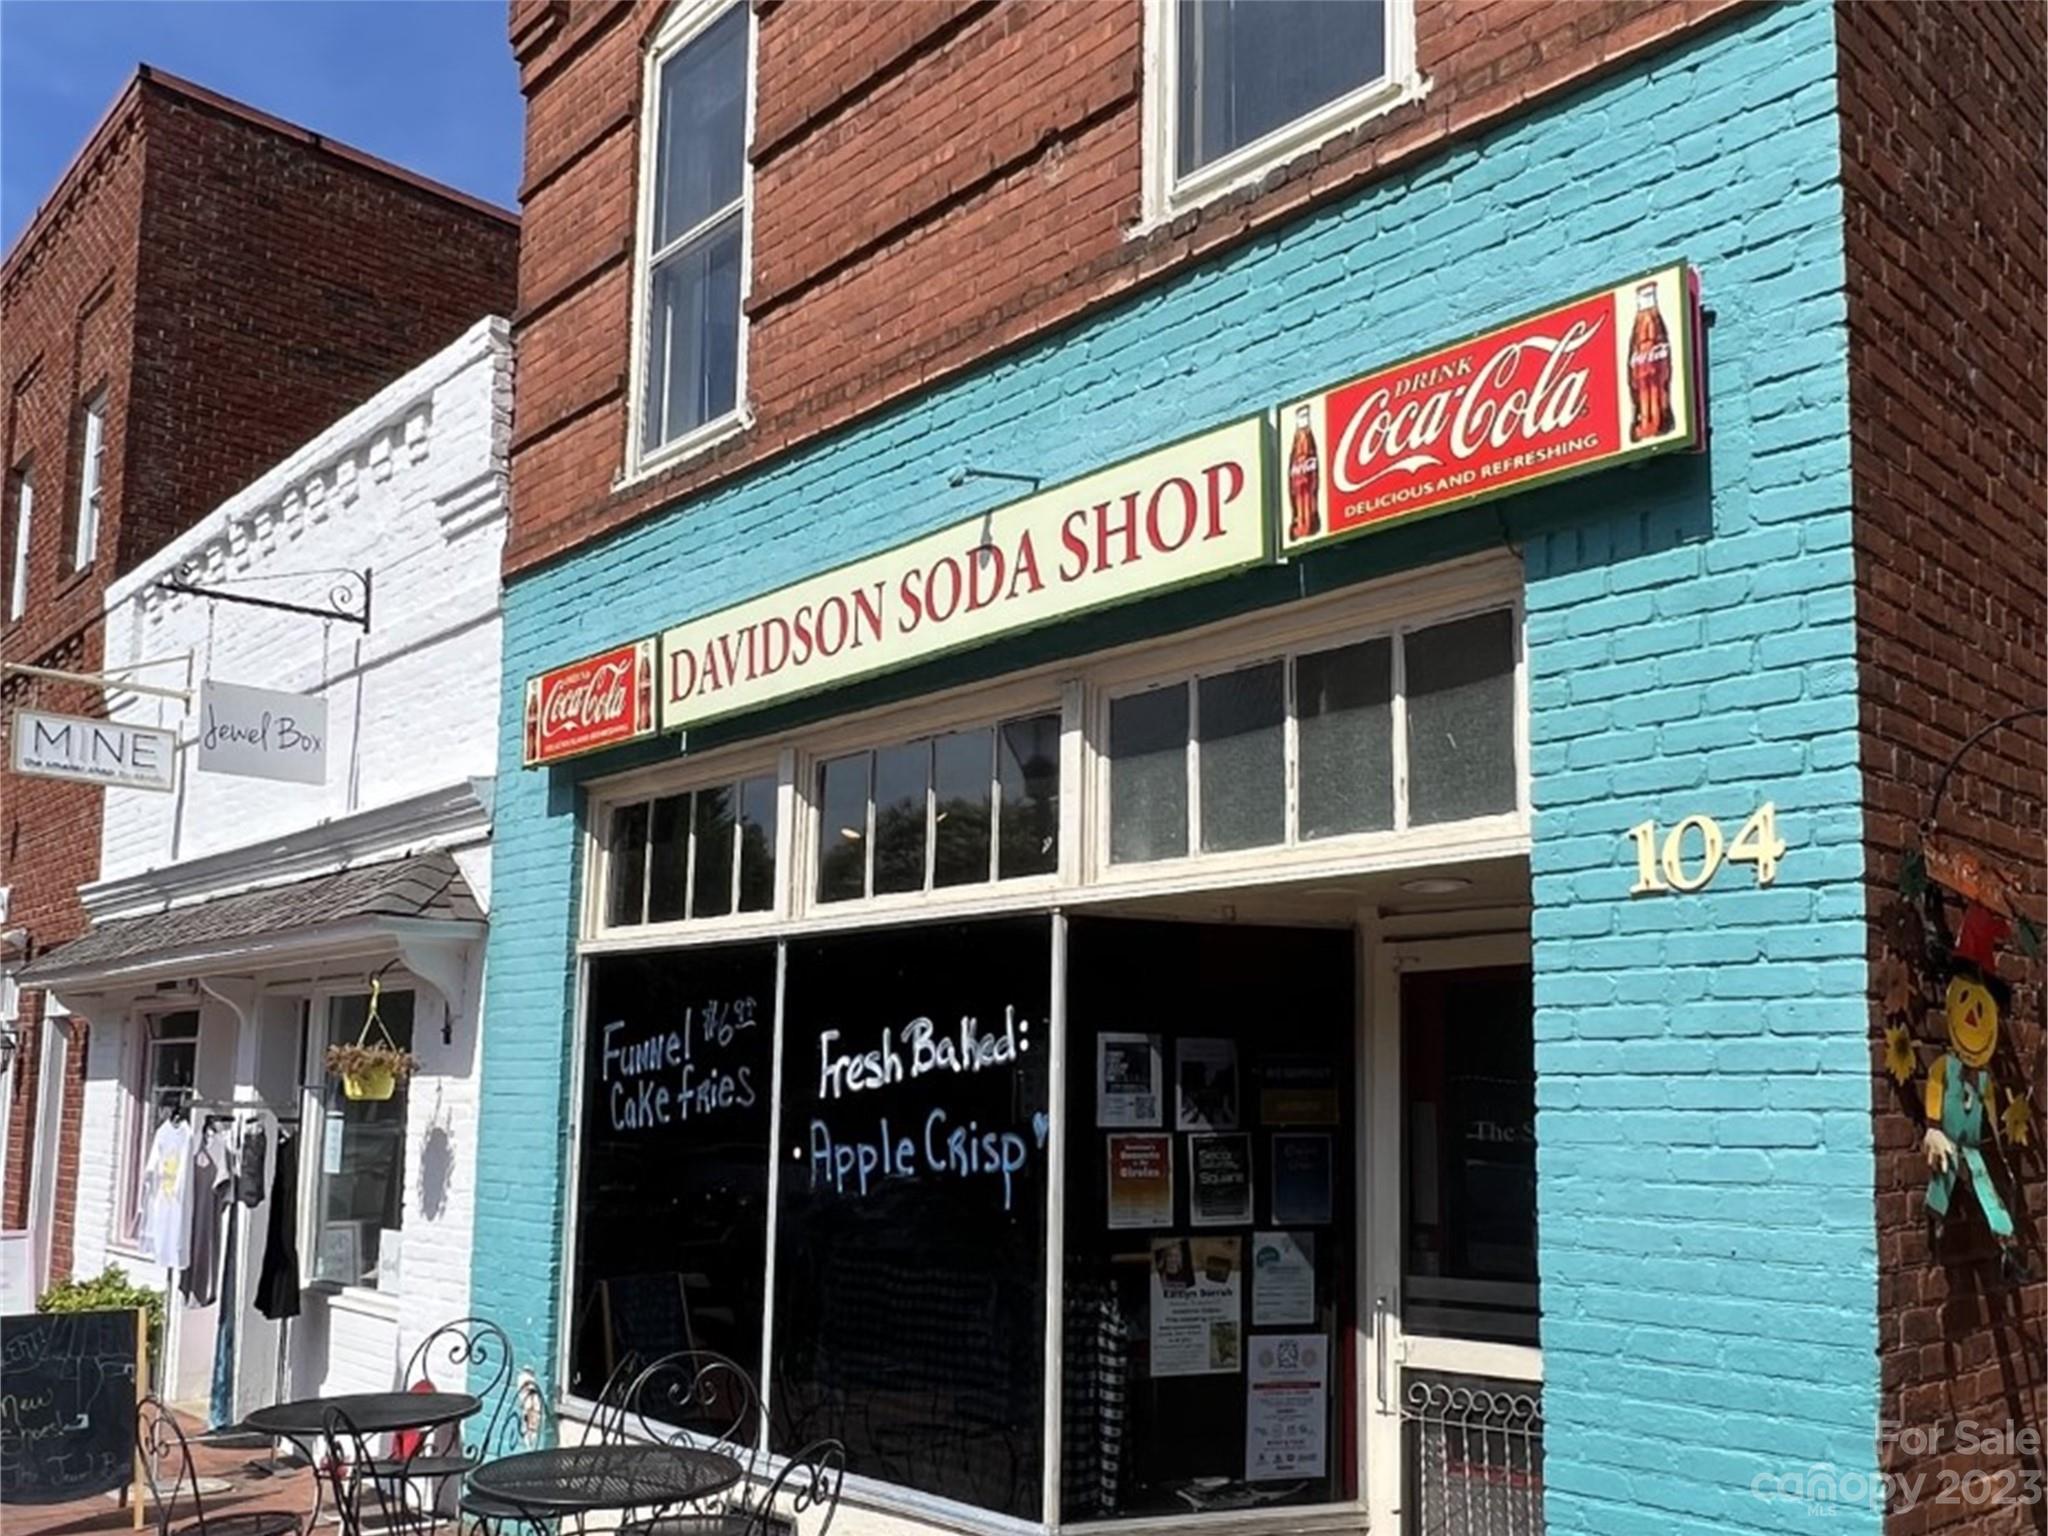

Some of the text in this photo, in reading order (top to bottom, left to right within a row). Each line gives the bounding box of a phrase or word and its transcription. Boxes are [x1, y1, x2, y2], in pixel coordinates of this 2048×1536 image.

[1333, 312, 1609, 492] Coca-Cola
[1394, 355, 1474, 398] DRINK
[1344, 433, 1599, 518] DELICIOUS AND REFRESHING
[669, 461, 1245, 704] DAVIDSON SODA SHOP
[204, 703, 322, 753] Jewel Box
[543, 658, 633, 737] Coca-Cola
[34, 720, 158, 768] MINE
[1629, 801, 1786, 896] 104
[603, 1007, 692, 1081] Funnel
[818, 1027, 903, 1099] Fresh
[810, 1117, 917, 1195] Apple
[1467, 1120, 1515, 1142] The
